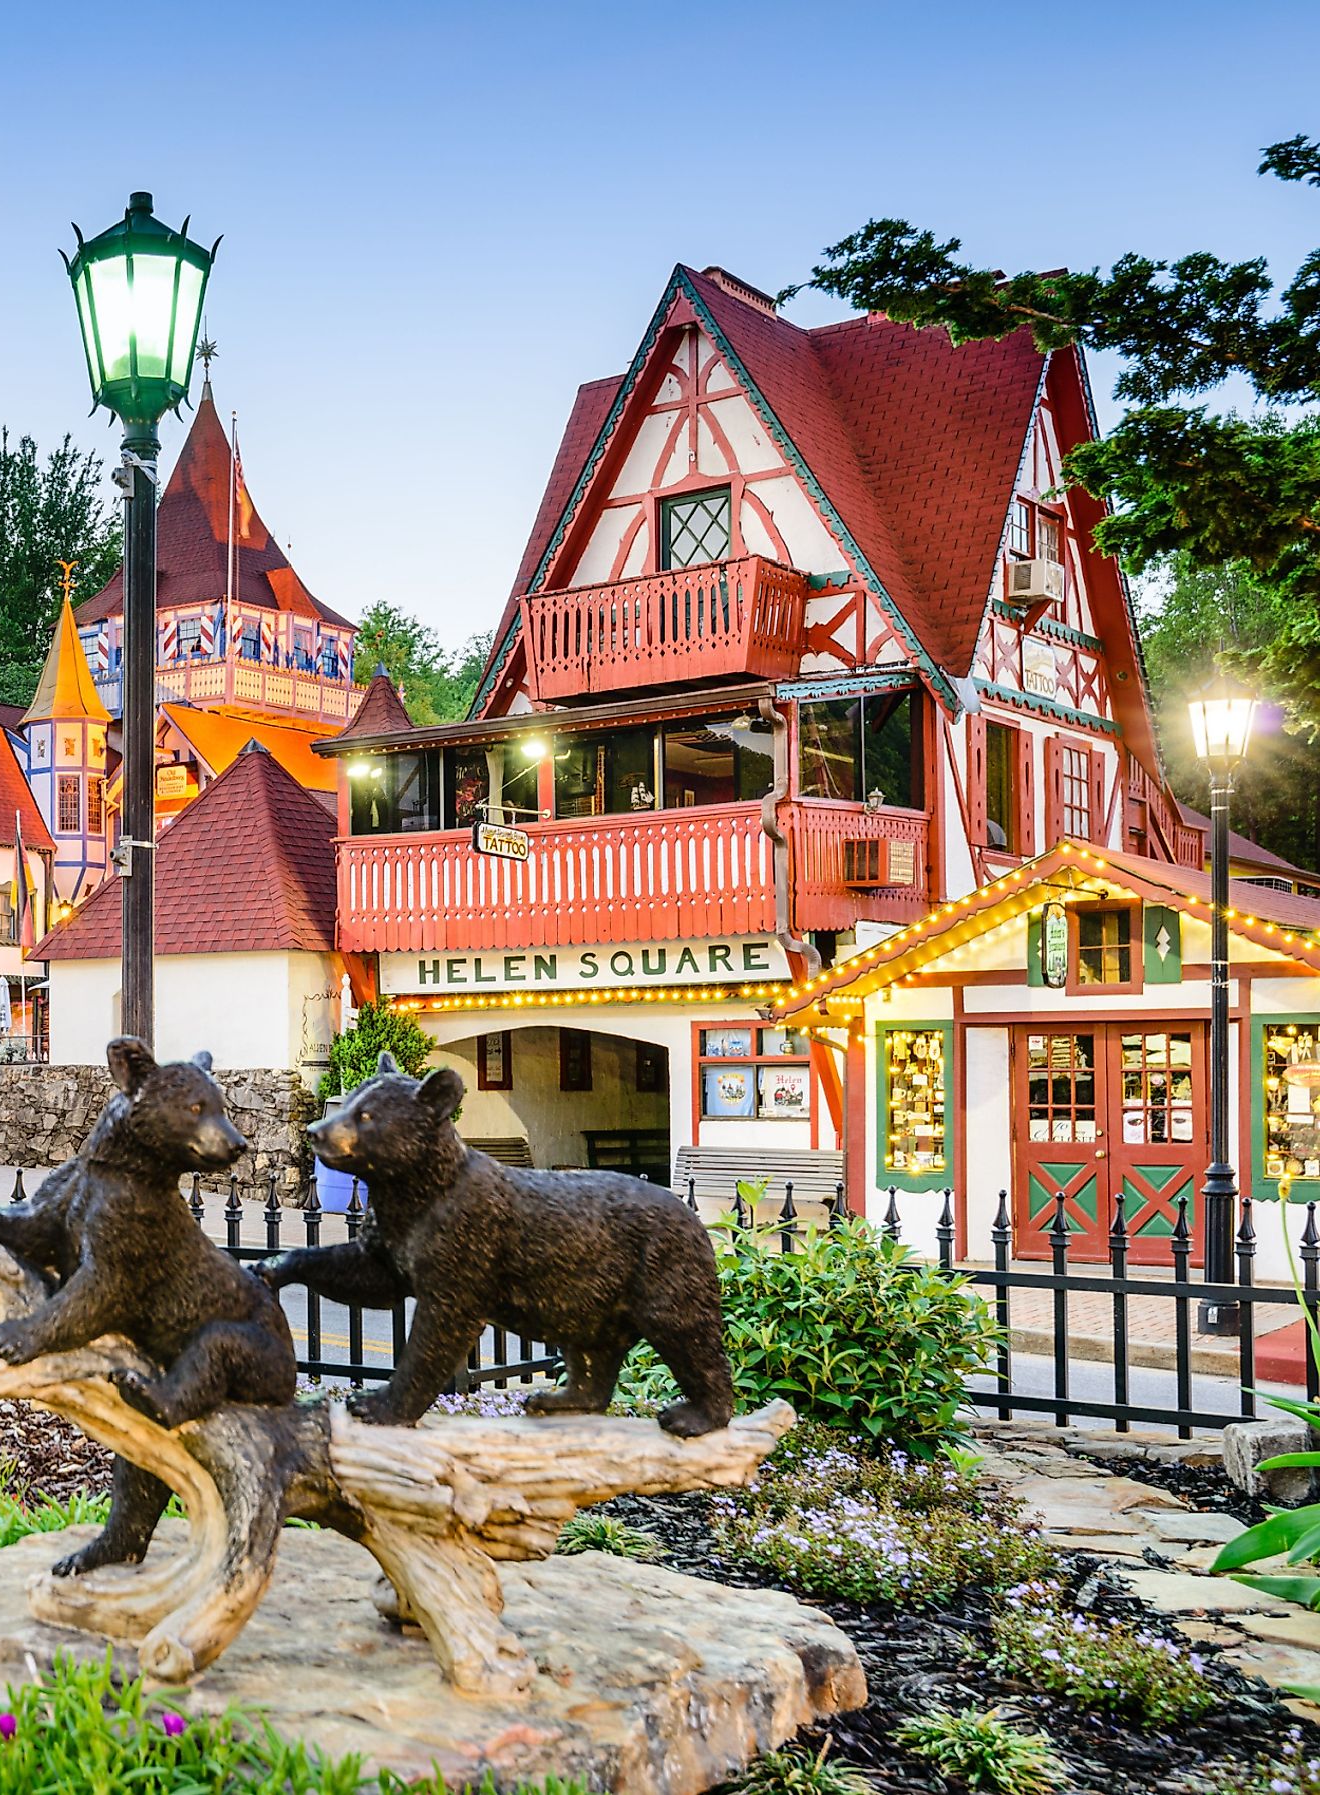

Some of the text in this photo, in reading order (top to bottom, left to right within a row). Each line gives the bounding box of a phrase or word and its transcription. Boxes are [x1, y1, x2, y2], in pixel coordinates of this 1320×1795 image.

[1025, 669, 1054, 694] TATTOO
[483, 836, 526, 857] TATTOO
[418, 942, 770, 985] HELEN SQUARE
[775, 1074, 802, 1085] Helen
